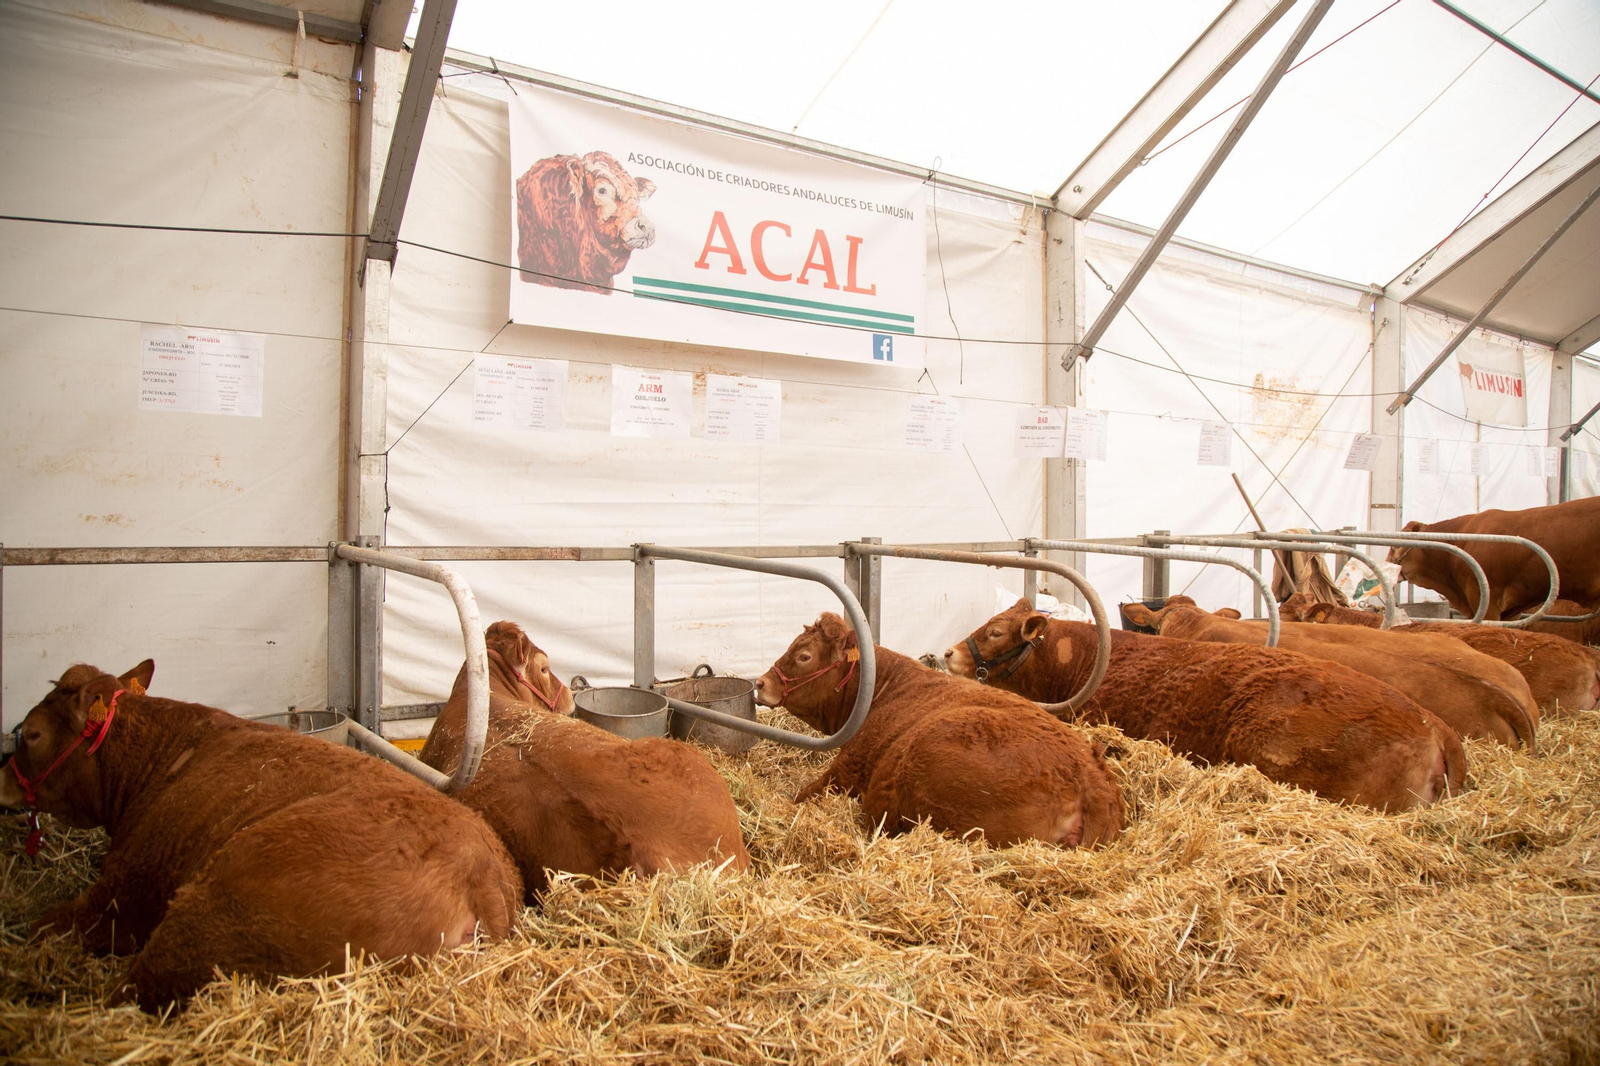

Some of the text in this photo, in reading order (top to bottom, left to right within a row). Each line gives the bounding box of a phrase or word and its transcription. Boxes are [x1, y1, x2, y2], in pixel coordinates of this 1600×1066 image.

[627, 151, 914, 221] ASOCIACIÓN DE CRIADORES ANDALUCES DE LIMUSÍN
[694, 210, 877, 296] ACAL
[638, 383, 663, 393] ARM
[1474, 370, 1523, 398] LIMUSIN
